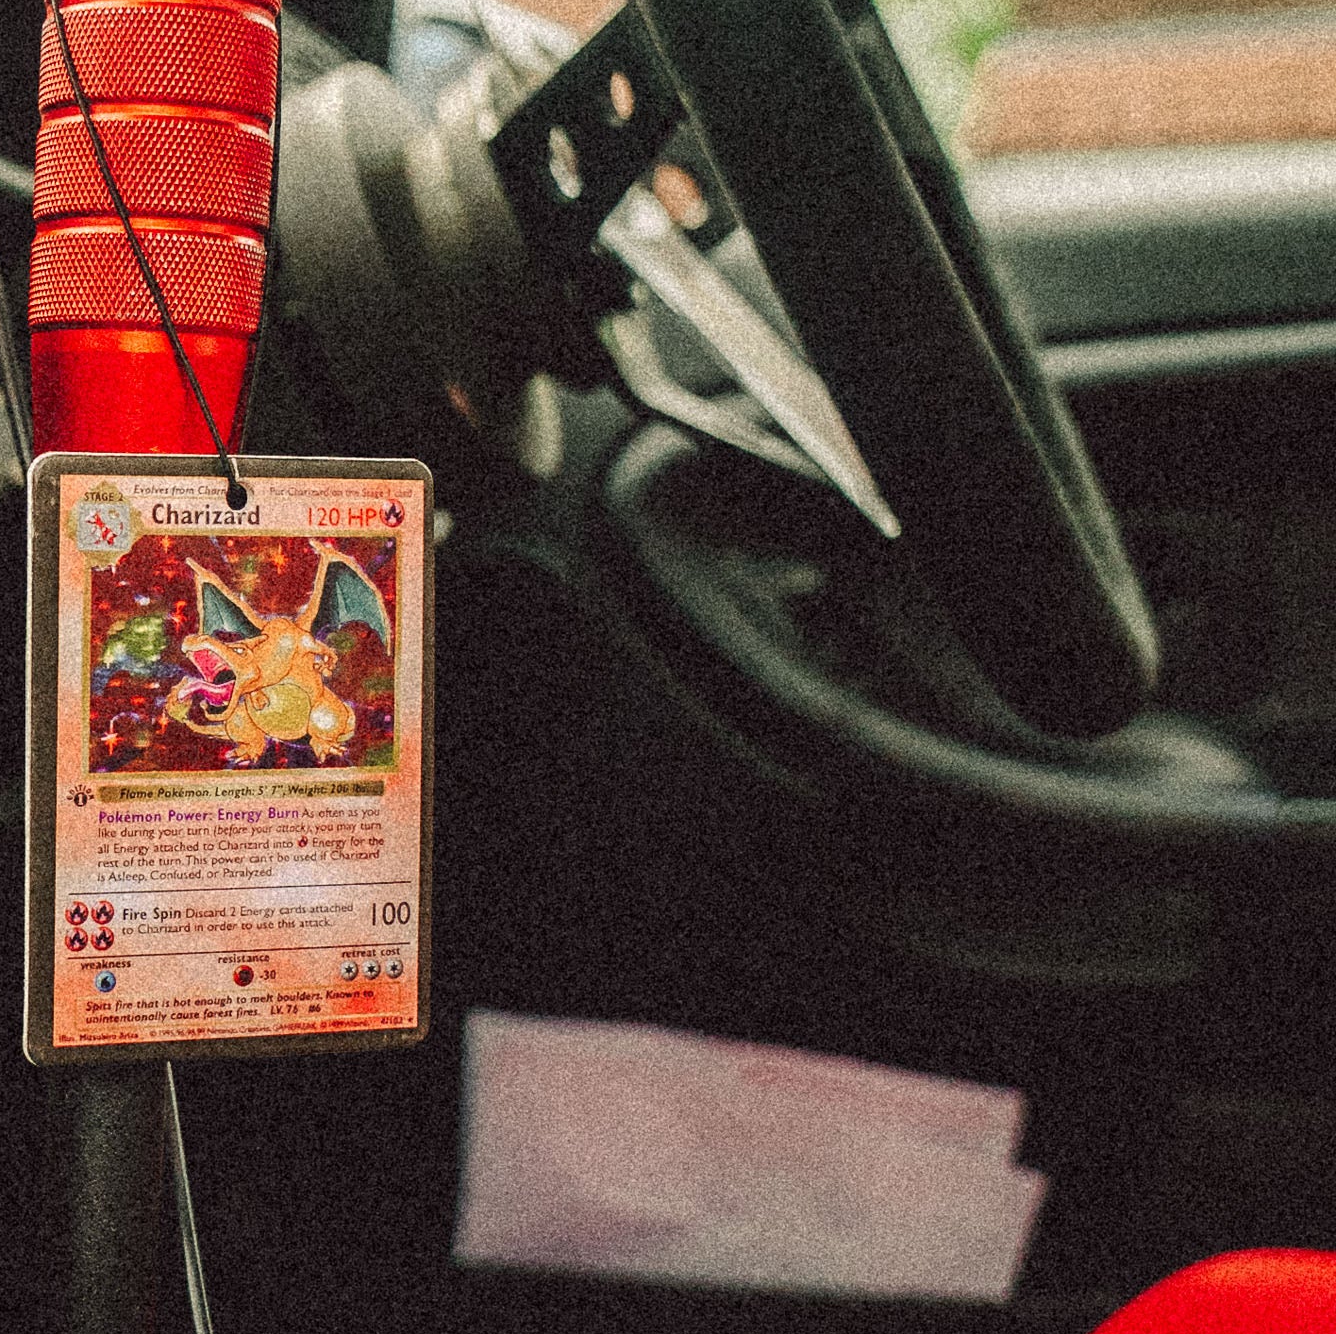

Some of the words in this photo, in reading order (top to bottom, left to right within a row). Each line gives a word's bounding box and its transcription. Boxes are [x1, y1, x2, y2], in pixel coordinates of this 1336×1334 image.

[85, 492, 112, 501] STAGE
[134, 484, 168, 495] Evolves
[171, 485, 194, 495] from
[152, 504, 259, 525] Charizard
[308, 507, 340, 526] 120
[349, 508, 376, 527] HP
[120, 788, 152, 799] Flame
[215, 787, 254, 798] Length:
[99, 810, 162, 823] Pokémon
[168, 809, 212, 821] Power:
[218, 808, 263, 824] Energy
[268, 807, 299, 818] Burn
[302, 809, 313, 818] As
[319, 809, 344, 817] often
[362, 809, 379, 818] you
[99, 829, 115, 838] like
[120, 827, 154, 839] during
[158, 828, 183, 839] your
[187, 827, 209, 835] turn
[213, 825, 247, 835] (before
[251, 825, 272, 835] your
[315, 825, 333, 834] you
[337, 824, 356, 834] may
[360, 822, 381, 830] turn
[98, 844, 109, 854] all
[114, 844, 149, 855] Energy
[153, 842, 199, 852] attached
[203, 843, 214, 851] to
[218, 840, 269, 851] Charizard
[273, 841, 293, 849] into
[313, 838, 346, 849] Energy
[350, 837, 365, 846] for
[368, 837, 384, 845] the
[98, 859, 118, 868] rest
[123, 858, 135, 867] of
[138, 858, 154, 866] the
[186, 856, 207, 865] This
[212, 855, 243, 867] power
[278, 854, 290, 862] be
[294, 853, 316, 861] used
[331, 850, 380, 860] Charizard
[98, 874, 105, 882] is
[109, 872, 146, 883] Asleep,
[122, 909, 147, 920] Fire
[154, 907, 181, 920] Spin
[186, 907, 226, 918] Discard
[231, 907, 236, 916] 2
[241, 907, 275, 918] Energy
[279, 906, 306, 914] cards
[310, 903, 353, 913] attached
[372, 901, 411, 925] 100
[122, 927, 133, 935] to
[138, 923, 190, 935] Charizard
[207, 923, 237, 931] order
[257, 921, 273, 929] use
[278, 920, 295, 928] this
[218, 955, 269, 964] resistance
[342, 949, 376, 958] retreat
[381, 948, 401, 956] cost
[81, 959, 131, 970] weakness
[260, 970, 276, 979] -30
[86, 1001, 112, 1013] Spits
[115, 1000, 132, 1012] fire
[137, 1000, 158, 1009] that
[163, 999, 169, 1007] is
[174, 998, 191, 1007] hot
[195, 996, 232, 1007] enough
[237, 995, 246, 1004] to
[251, 993, 273, 1003] melt
[326, 990, 360, 999] Known
[86, 1012, 166, 1024] unintentionally
[171, 1011, 199, 1020] cause
[203, 1008, 232, 1019] forest
[237, 1006, 260, 1018] fires.
[271, 1006, 284, 1015] LV.
[287, 1005, 298, 1014] 76
